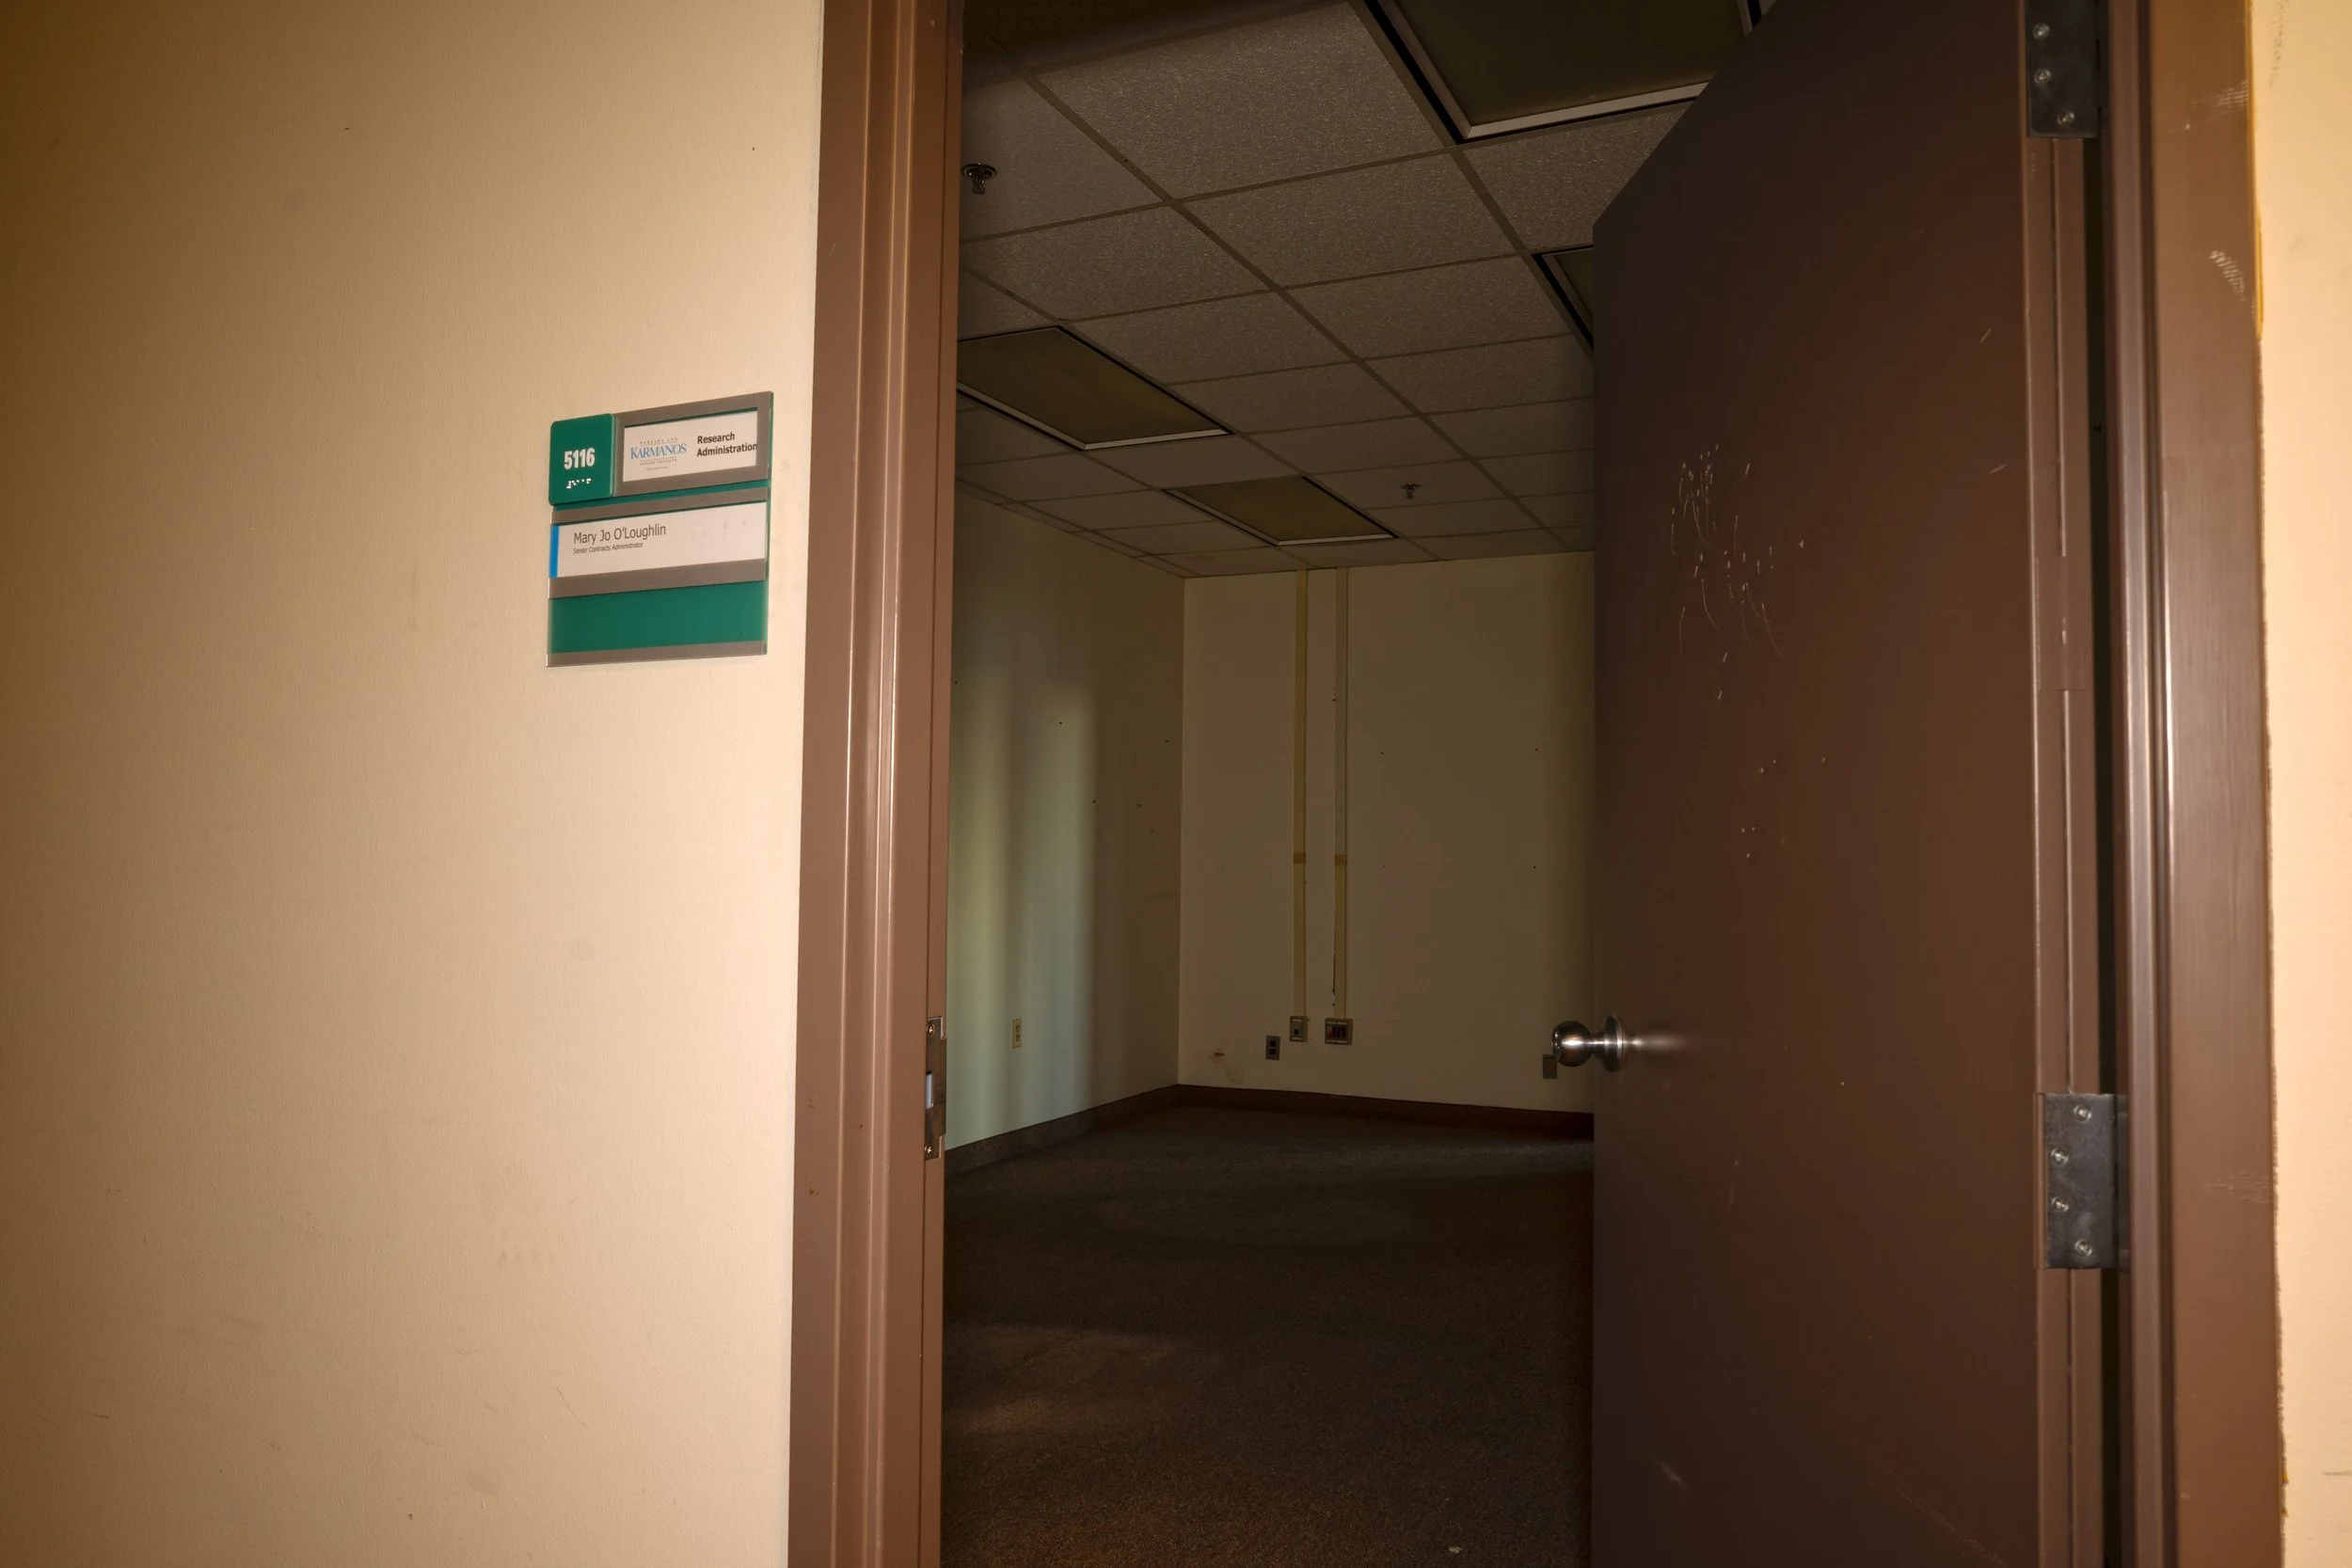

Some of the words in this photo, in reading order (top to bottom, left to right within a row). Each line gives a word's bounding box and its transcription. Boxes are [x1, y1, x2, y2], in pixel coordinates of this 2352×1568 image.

[697, 432, 735, 444] Research
[630, 442, 687, 460] KARMANOS
[696, 443, 757, 457] Administration
[564, 447, 596, 470] 5116
[573, 531, 597, 546] Mary
[599, 530, 612, 542] Jo
[613, 524, 666, 541] O'Loughlin
[588, 545, 612, 553] Contracts
[612, 542, 644, 550] Administrator
